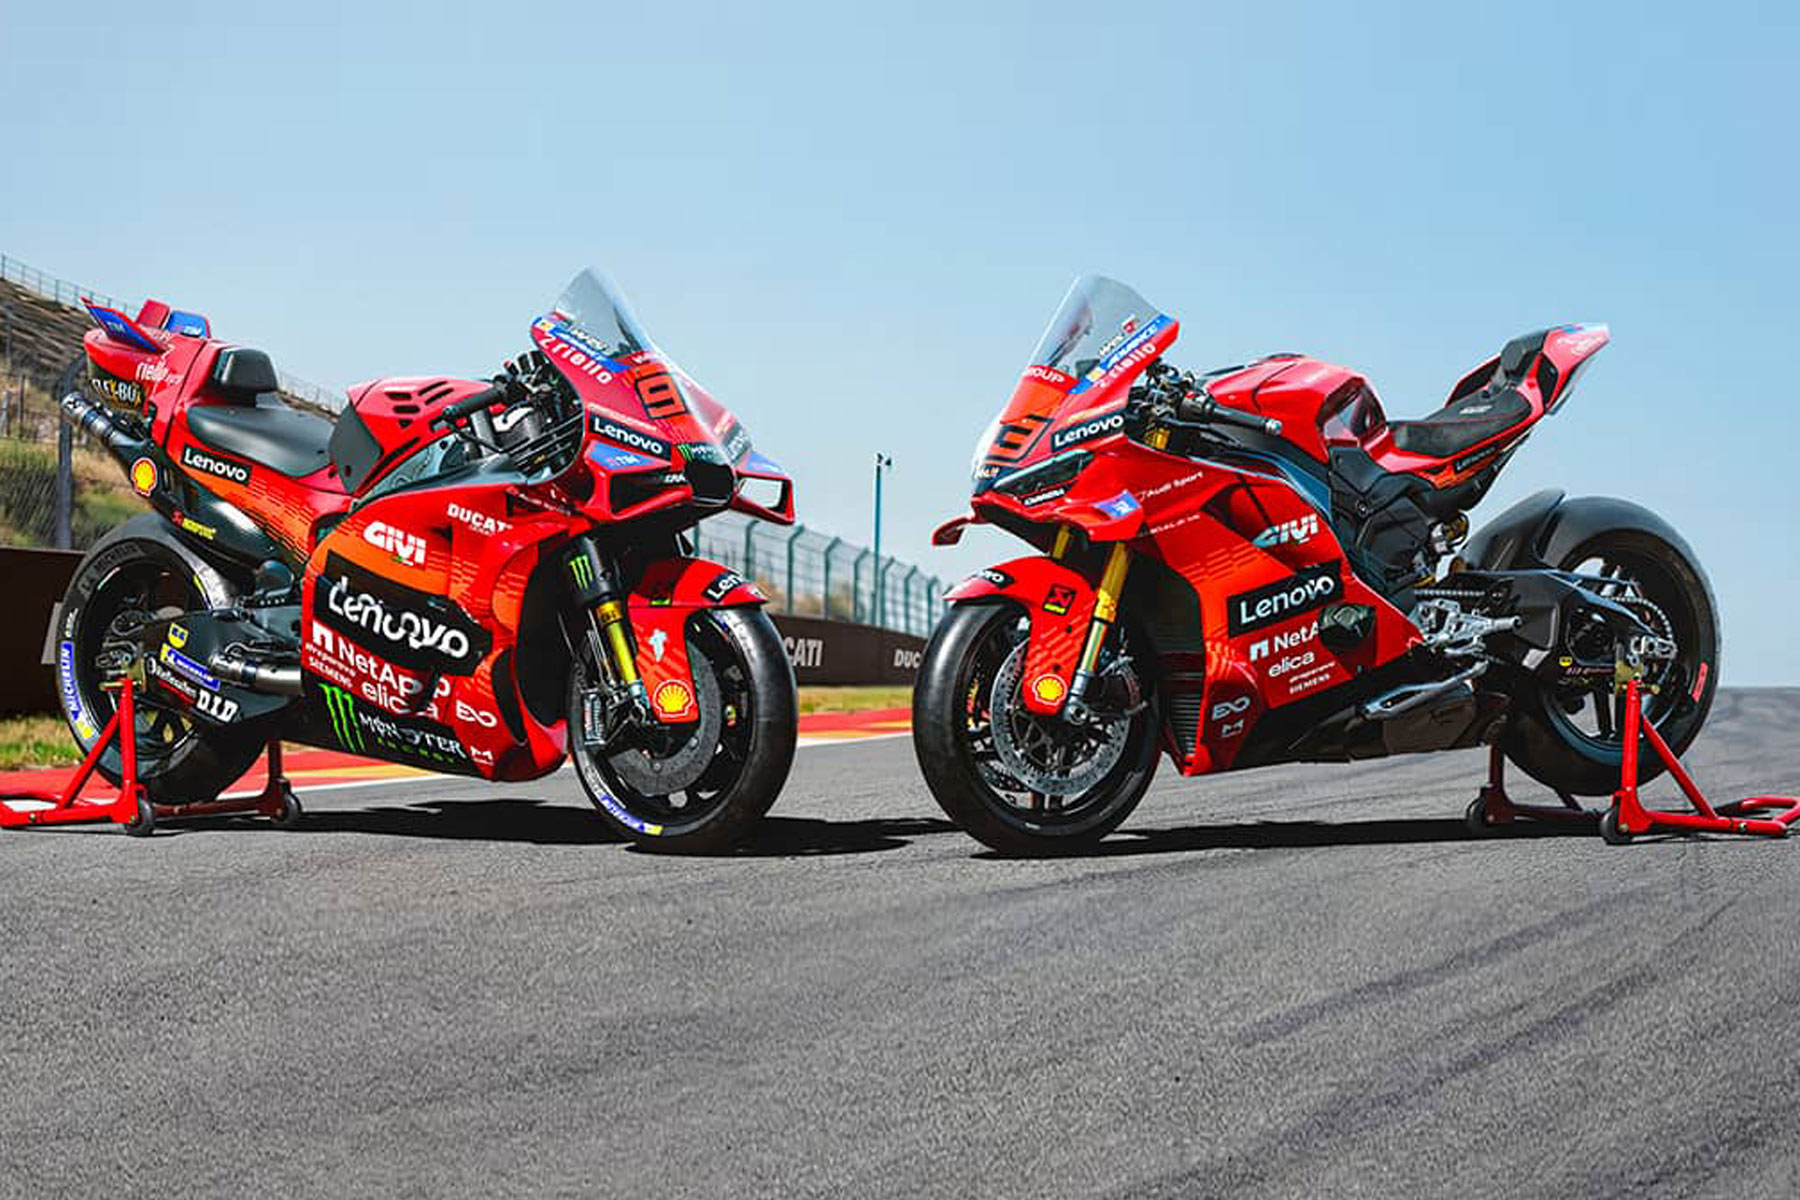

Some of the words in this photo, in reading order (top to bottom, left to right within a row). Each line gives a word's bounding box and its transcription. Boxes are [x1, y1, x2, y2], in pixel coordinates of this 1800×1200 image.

[594, 417, 663, 454] Lenovo
[1054, 414, 1125, 448] Lenovo
[184, 447, 247, 481] Lenovo
[363, 520, 427, 565] GIVI
[1254, 514, 1319, 548] GIVI
[329, 575, 469, 658] Lenovo
[1239, 575, 1335, 625] Lenovo
[1268, 651, 1315, 677] elica
